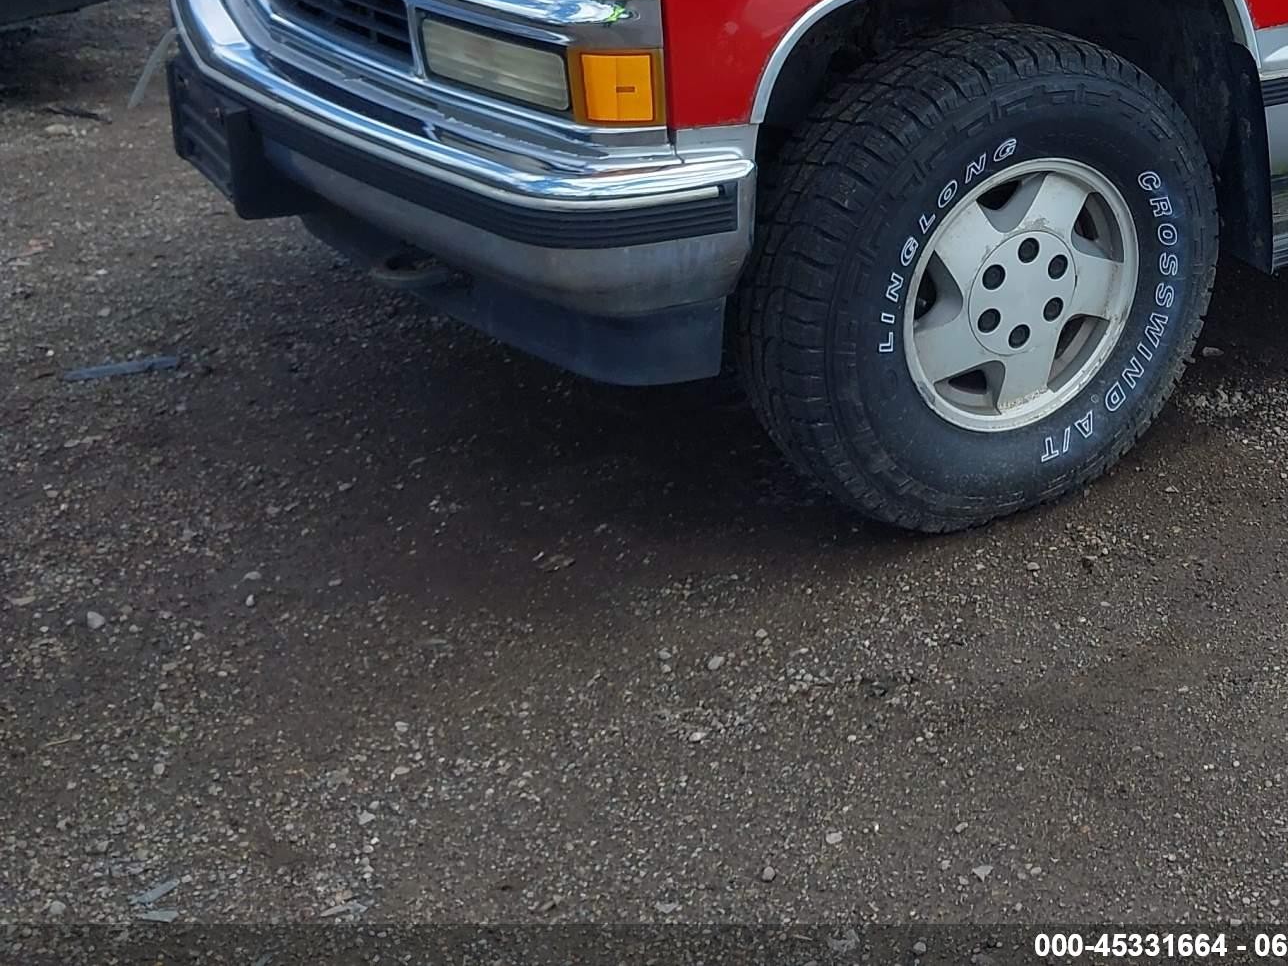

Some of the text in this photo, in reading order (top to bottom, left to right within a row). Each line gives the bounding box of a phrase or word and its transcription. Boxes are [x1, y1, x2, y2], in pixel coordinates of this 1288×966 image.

[879, 139, 1017, 353] LINGLONG
[1041, 171, 1179, 462] CROSSWIND A/T
